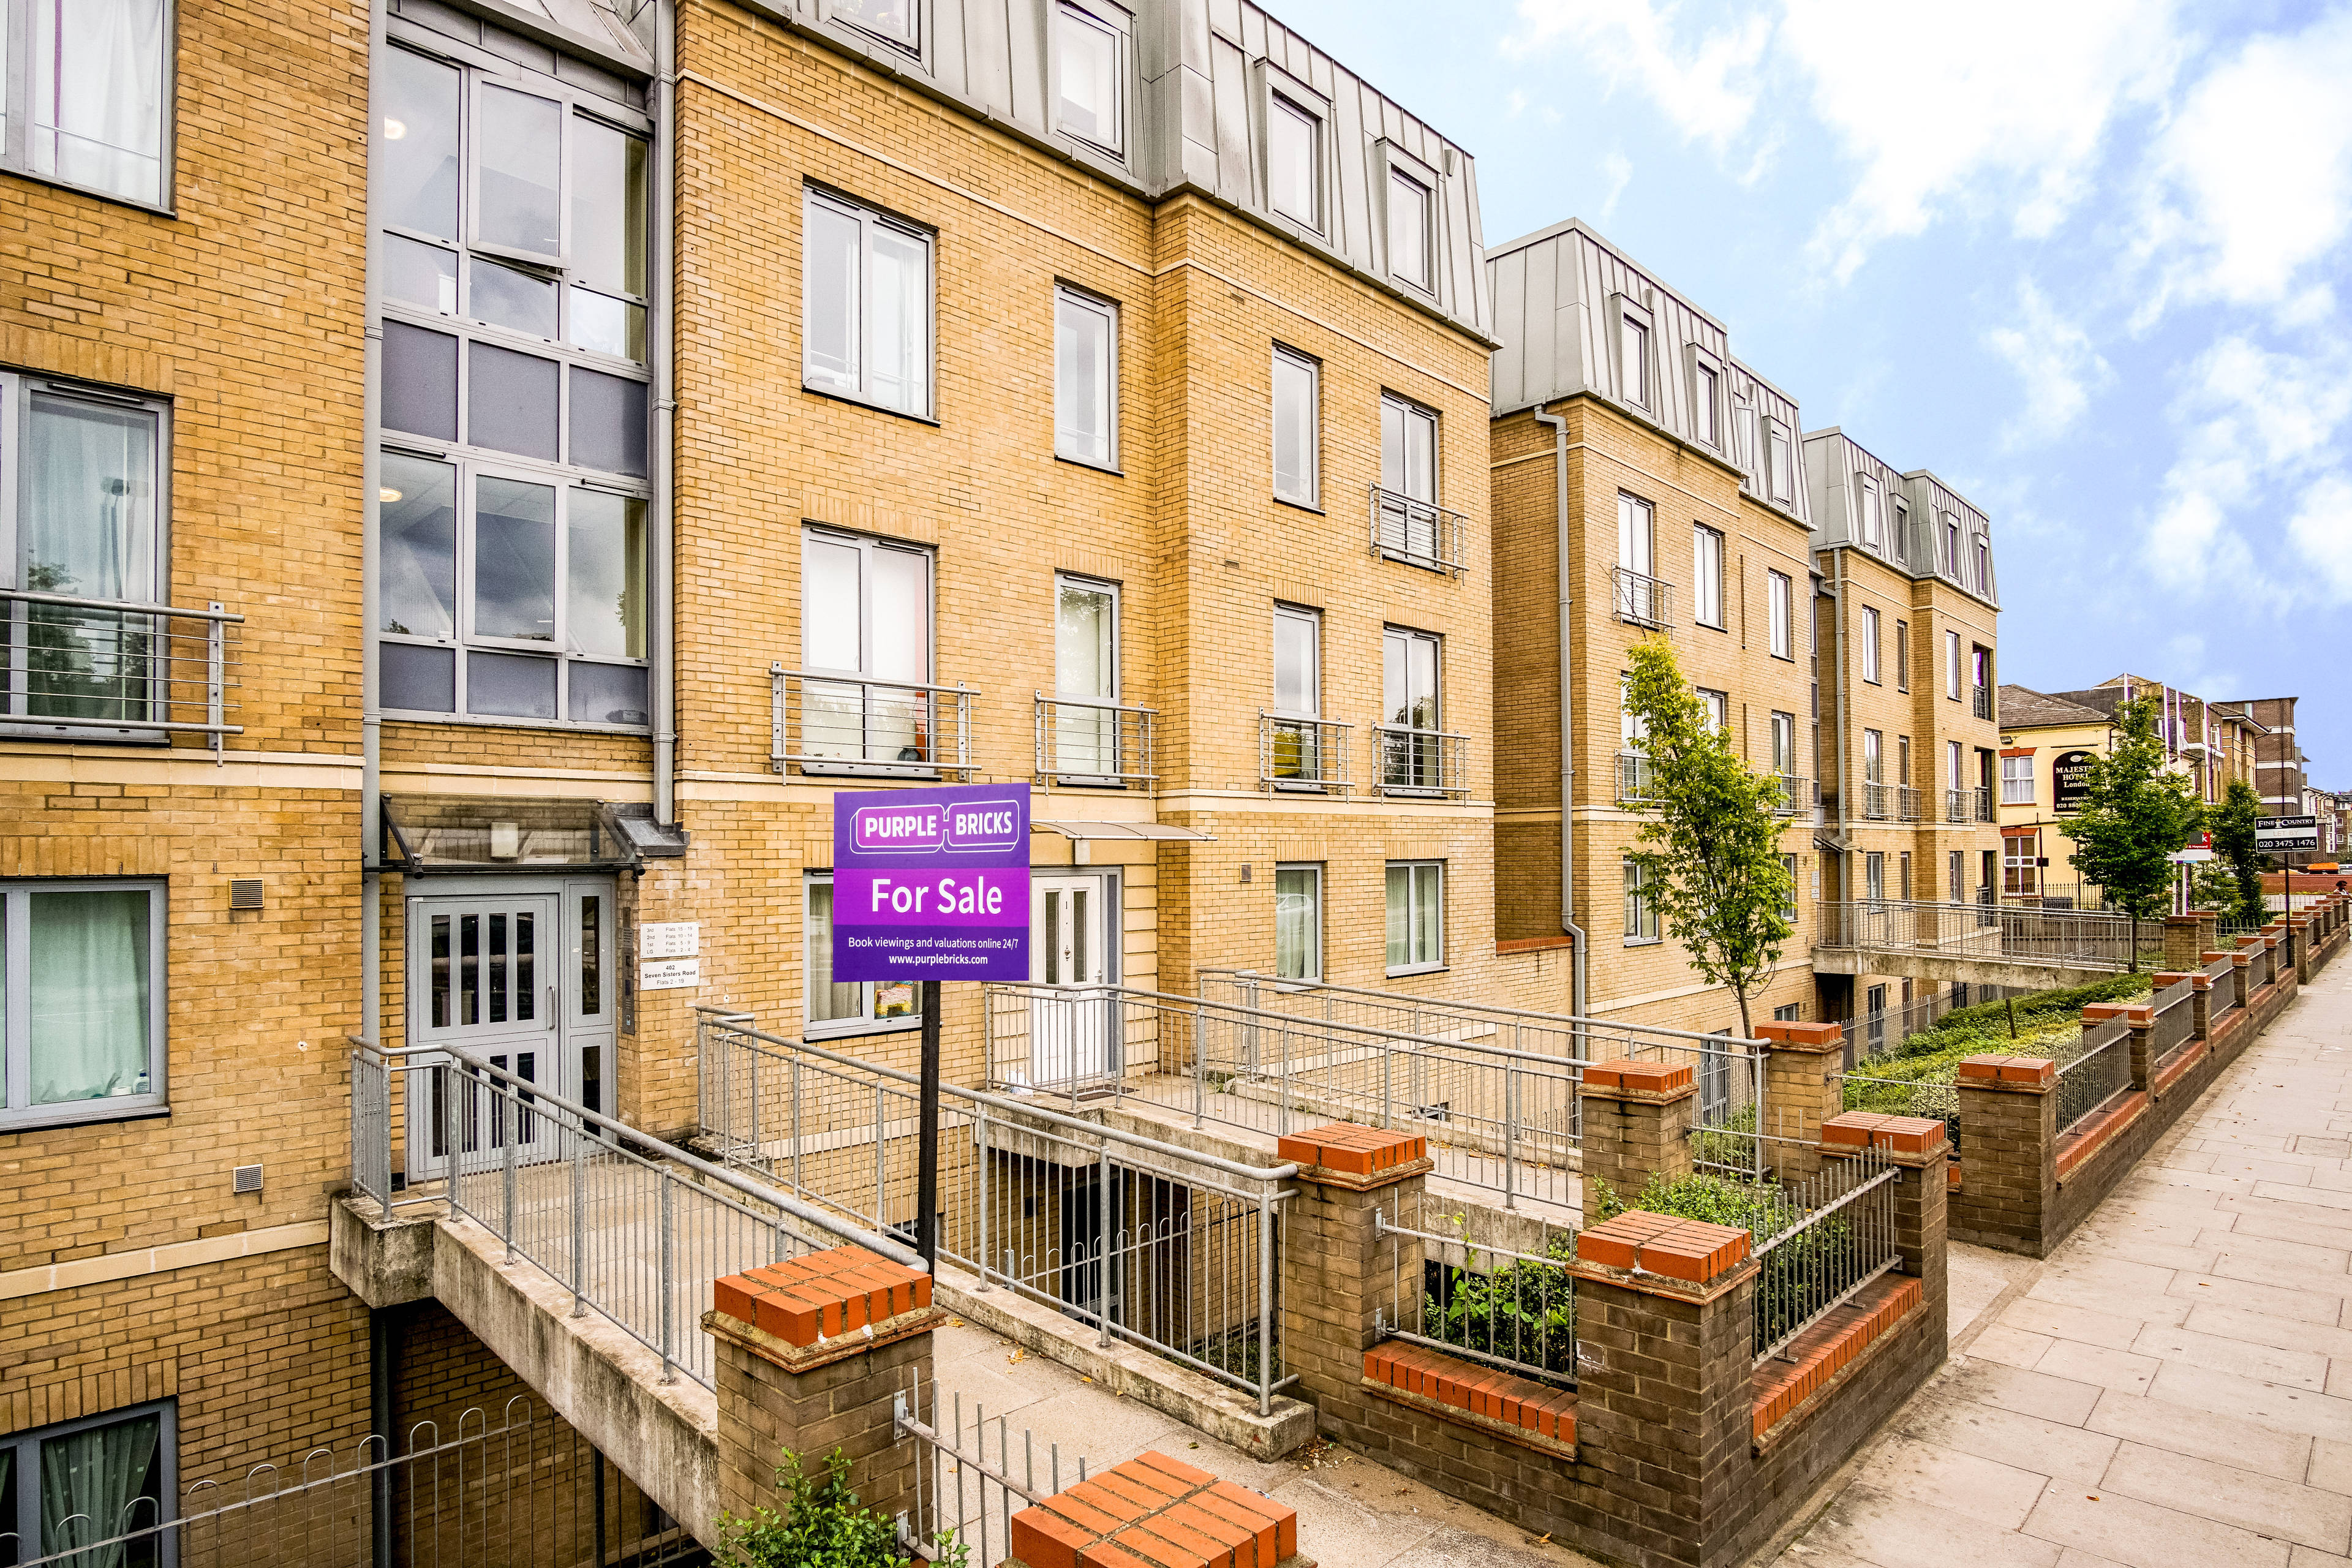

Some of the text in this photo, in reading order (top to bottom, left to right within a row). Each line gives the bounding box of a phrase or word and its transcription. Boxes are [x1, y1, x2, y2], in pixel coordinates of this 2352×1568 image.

[865, 811, 1012, 838] PURPLE BRICKS
[872, 875, 1003, 915] For Sale
[848, 937, 1019, 951] Book viewings and valuations online 24/7
[889, 954, 988, 967] www.purplebricks.com
